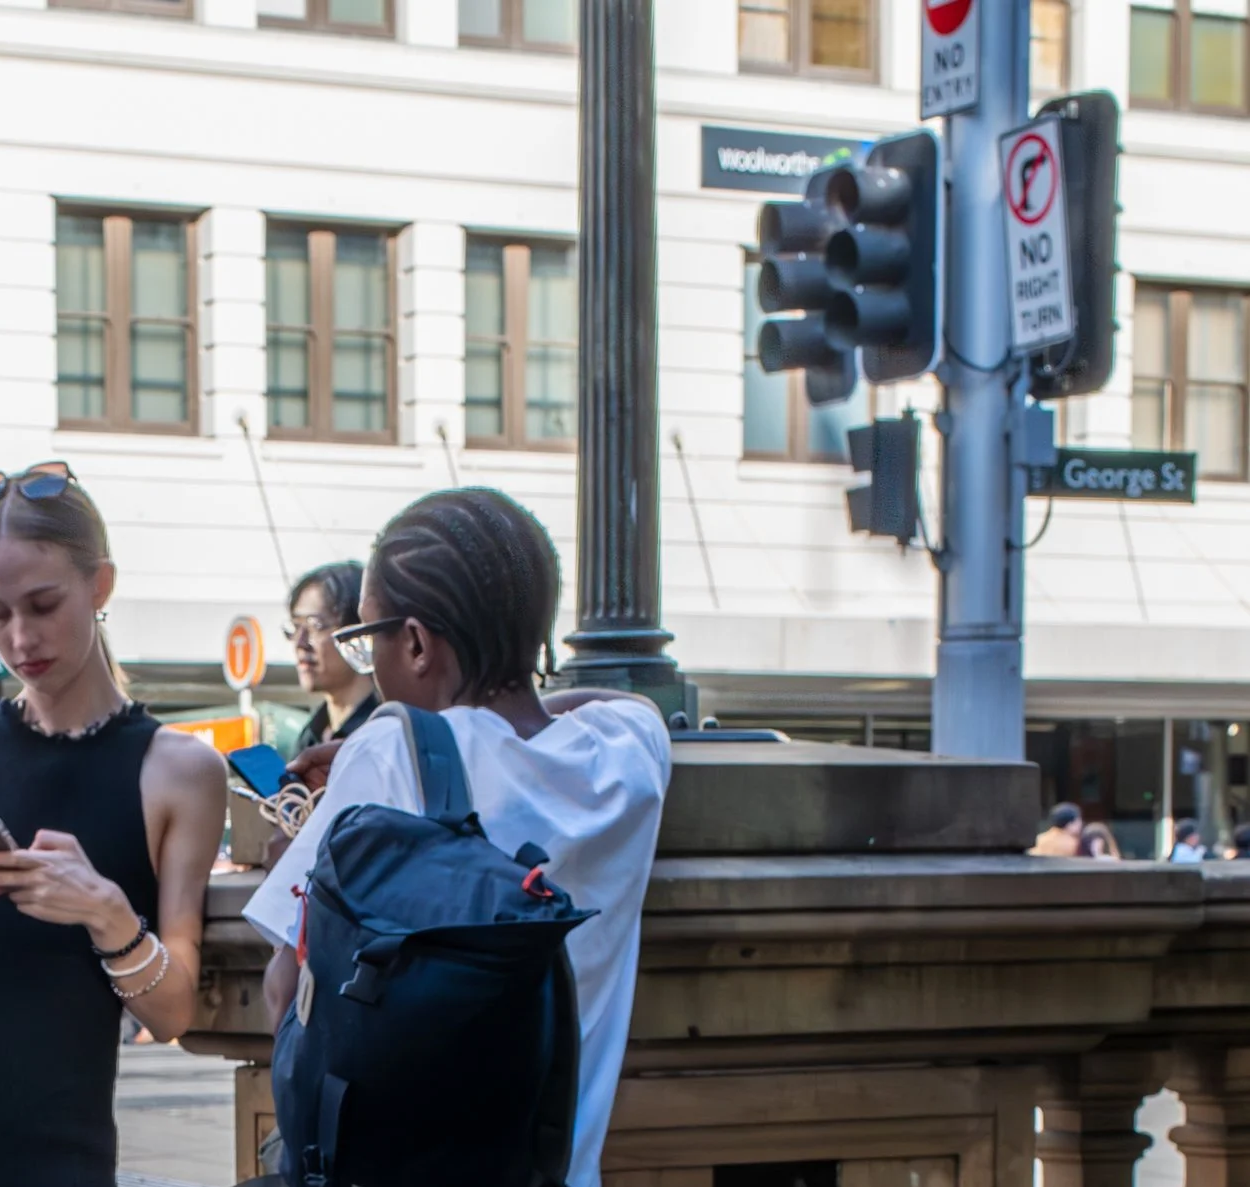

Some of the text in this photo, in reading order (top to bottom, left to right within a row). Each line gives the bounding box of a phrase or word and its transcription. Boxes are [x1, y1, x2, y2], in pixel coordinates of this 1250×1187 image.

[933, 41, 965, 74] NO
[924, 74, 973, 107] ENTRY
[1019, 232, 1054, 270] NO
[1015, 269, 1061, 301] RIGHT
[1020, 303, 1065, 333] TURN
[1063, 457, 1186, 498] George St
